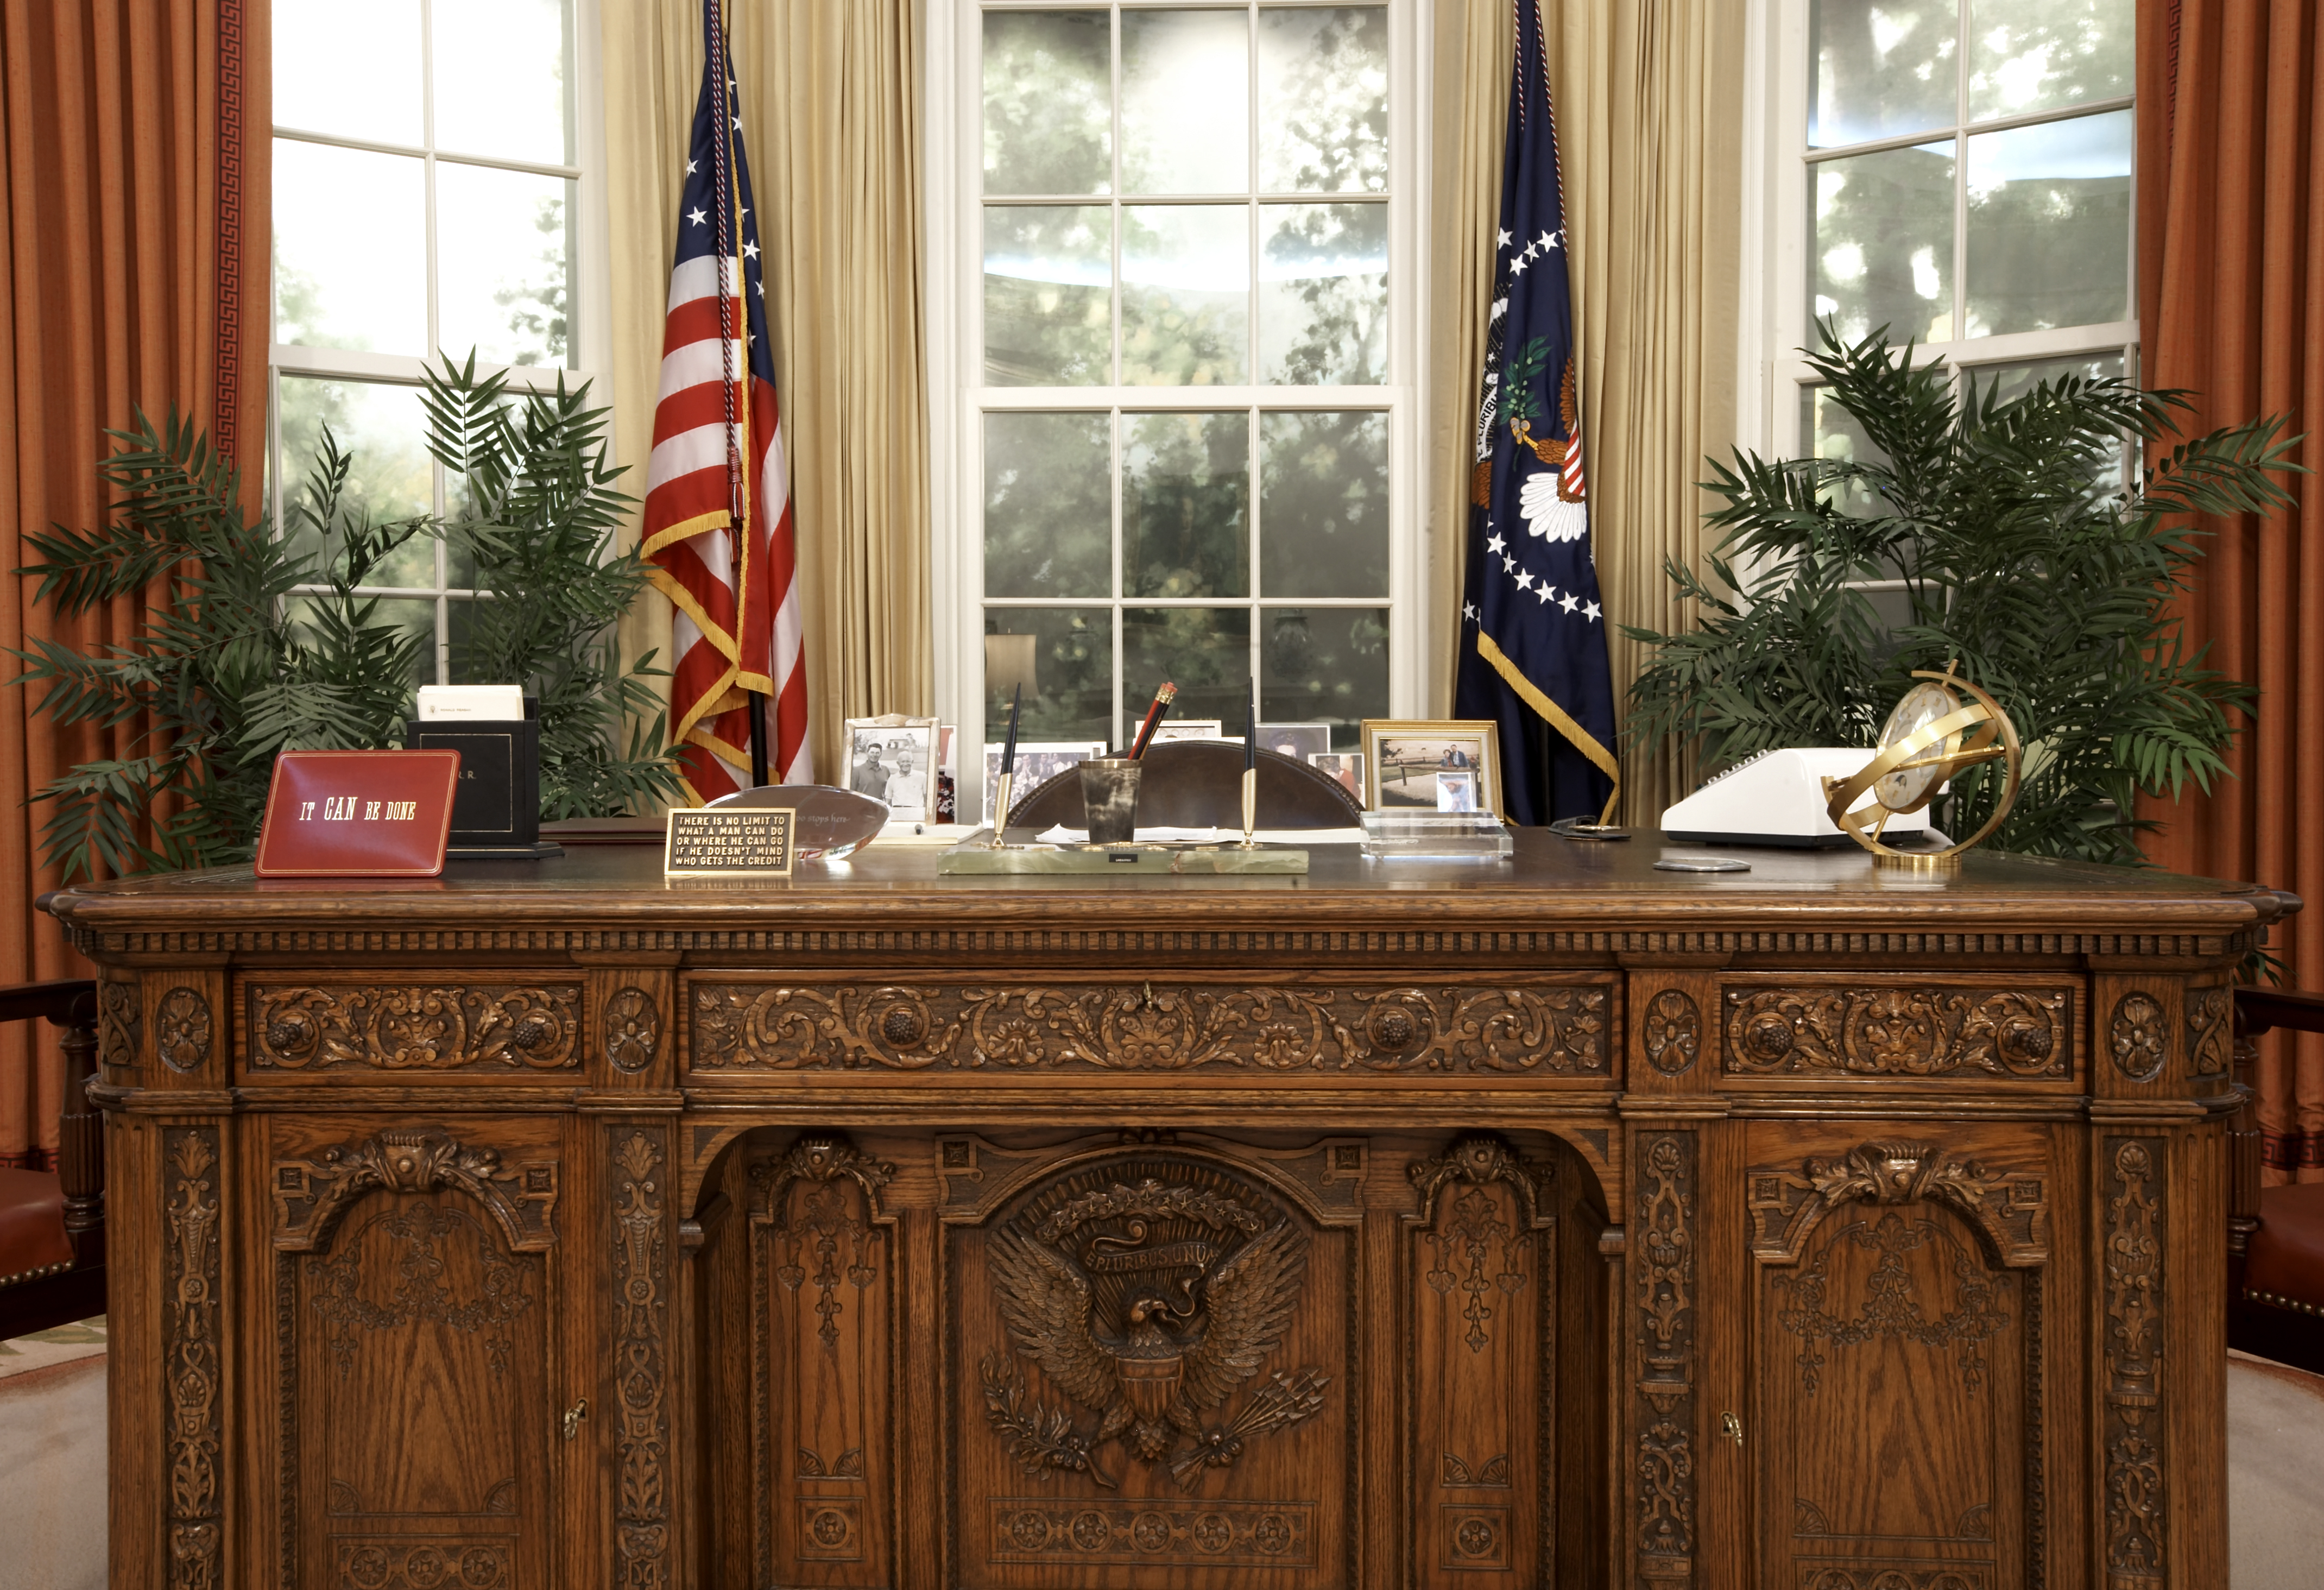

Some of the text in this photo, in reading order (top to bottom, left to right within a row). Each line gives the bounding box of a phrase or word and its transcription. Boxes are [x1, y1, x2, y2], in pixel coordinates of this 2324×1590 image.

[299, 797, 416, 821] IT CAN BE DONE
[680, 817, 785, 825] THERE IS NO LIMIT TO
[807, 815, 829, 826] stops
[831, 812, 851, 823] here
[678, 827, 784, 836] WHAT A MAN CAN DO
[677, 837, 783, 846] OR WHERE HE CAN GO
[690, 847, 702, 855] HE
[708, 847, 750, 855] DOESN'T
[757, 847, 782, 855] MIND
[675, 857, 696, 866] WHO
[700, 857, 723, 865] GETS
[748, 857, 782, 865] CREDIT
[1085, 1251, 1096, 1266] E
[1095, 1249, 1168, 1271] PLURIBUS
